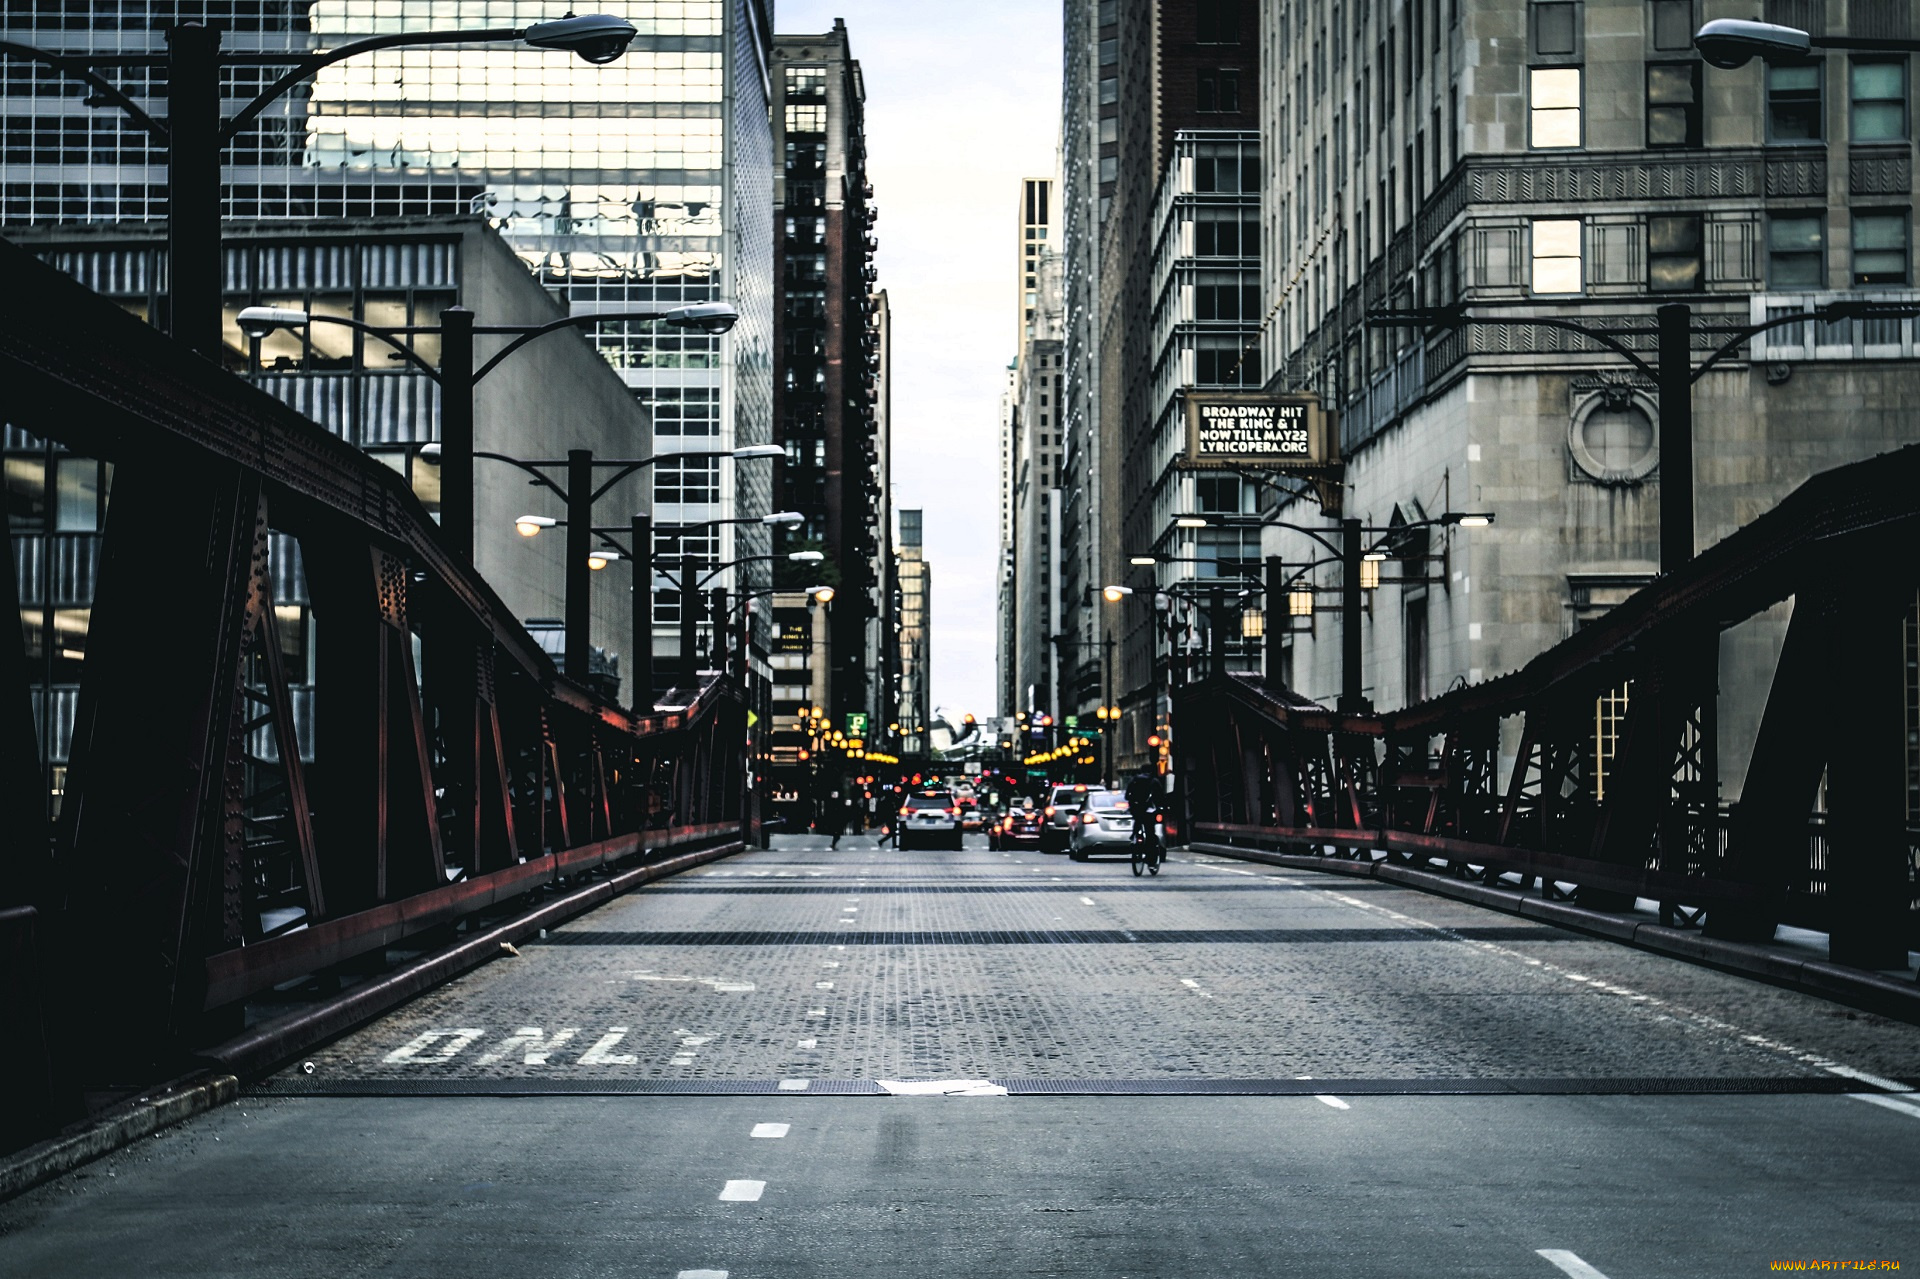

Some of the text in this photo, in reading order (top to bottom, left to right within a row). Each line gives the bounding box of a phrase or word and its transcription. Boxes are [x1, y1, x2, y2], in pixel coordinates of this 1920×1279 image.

[1202, 407, 1303, 417] BROADWAY HIT
[1208, 418, 1298, 429] THE KING & I
[1200, 430, 1231, 441] NOW
[1232, 430, 1261, 441] TILL
[1200, 442, 1307, 453] LYRICOPERA.ORG
[381, 1027, 720, 1066] ONLY
